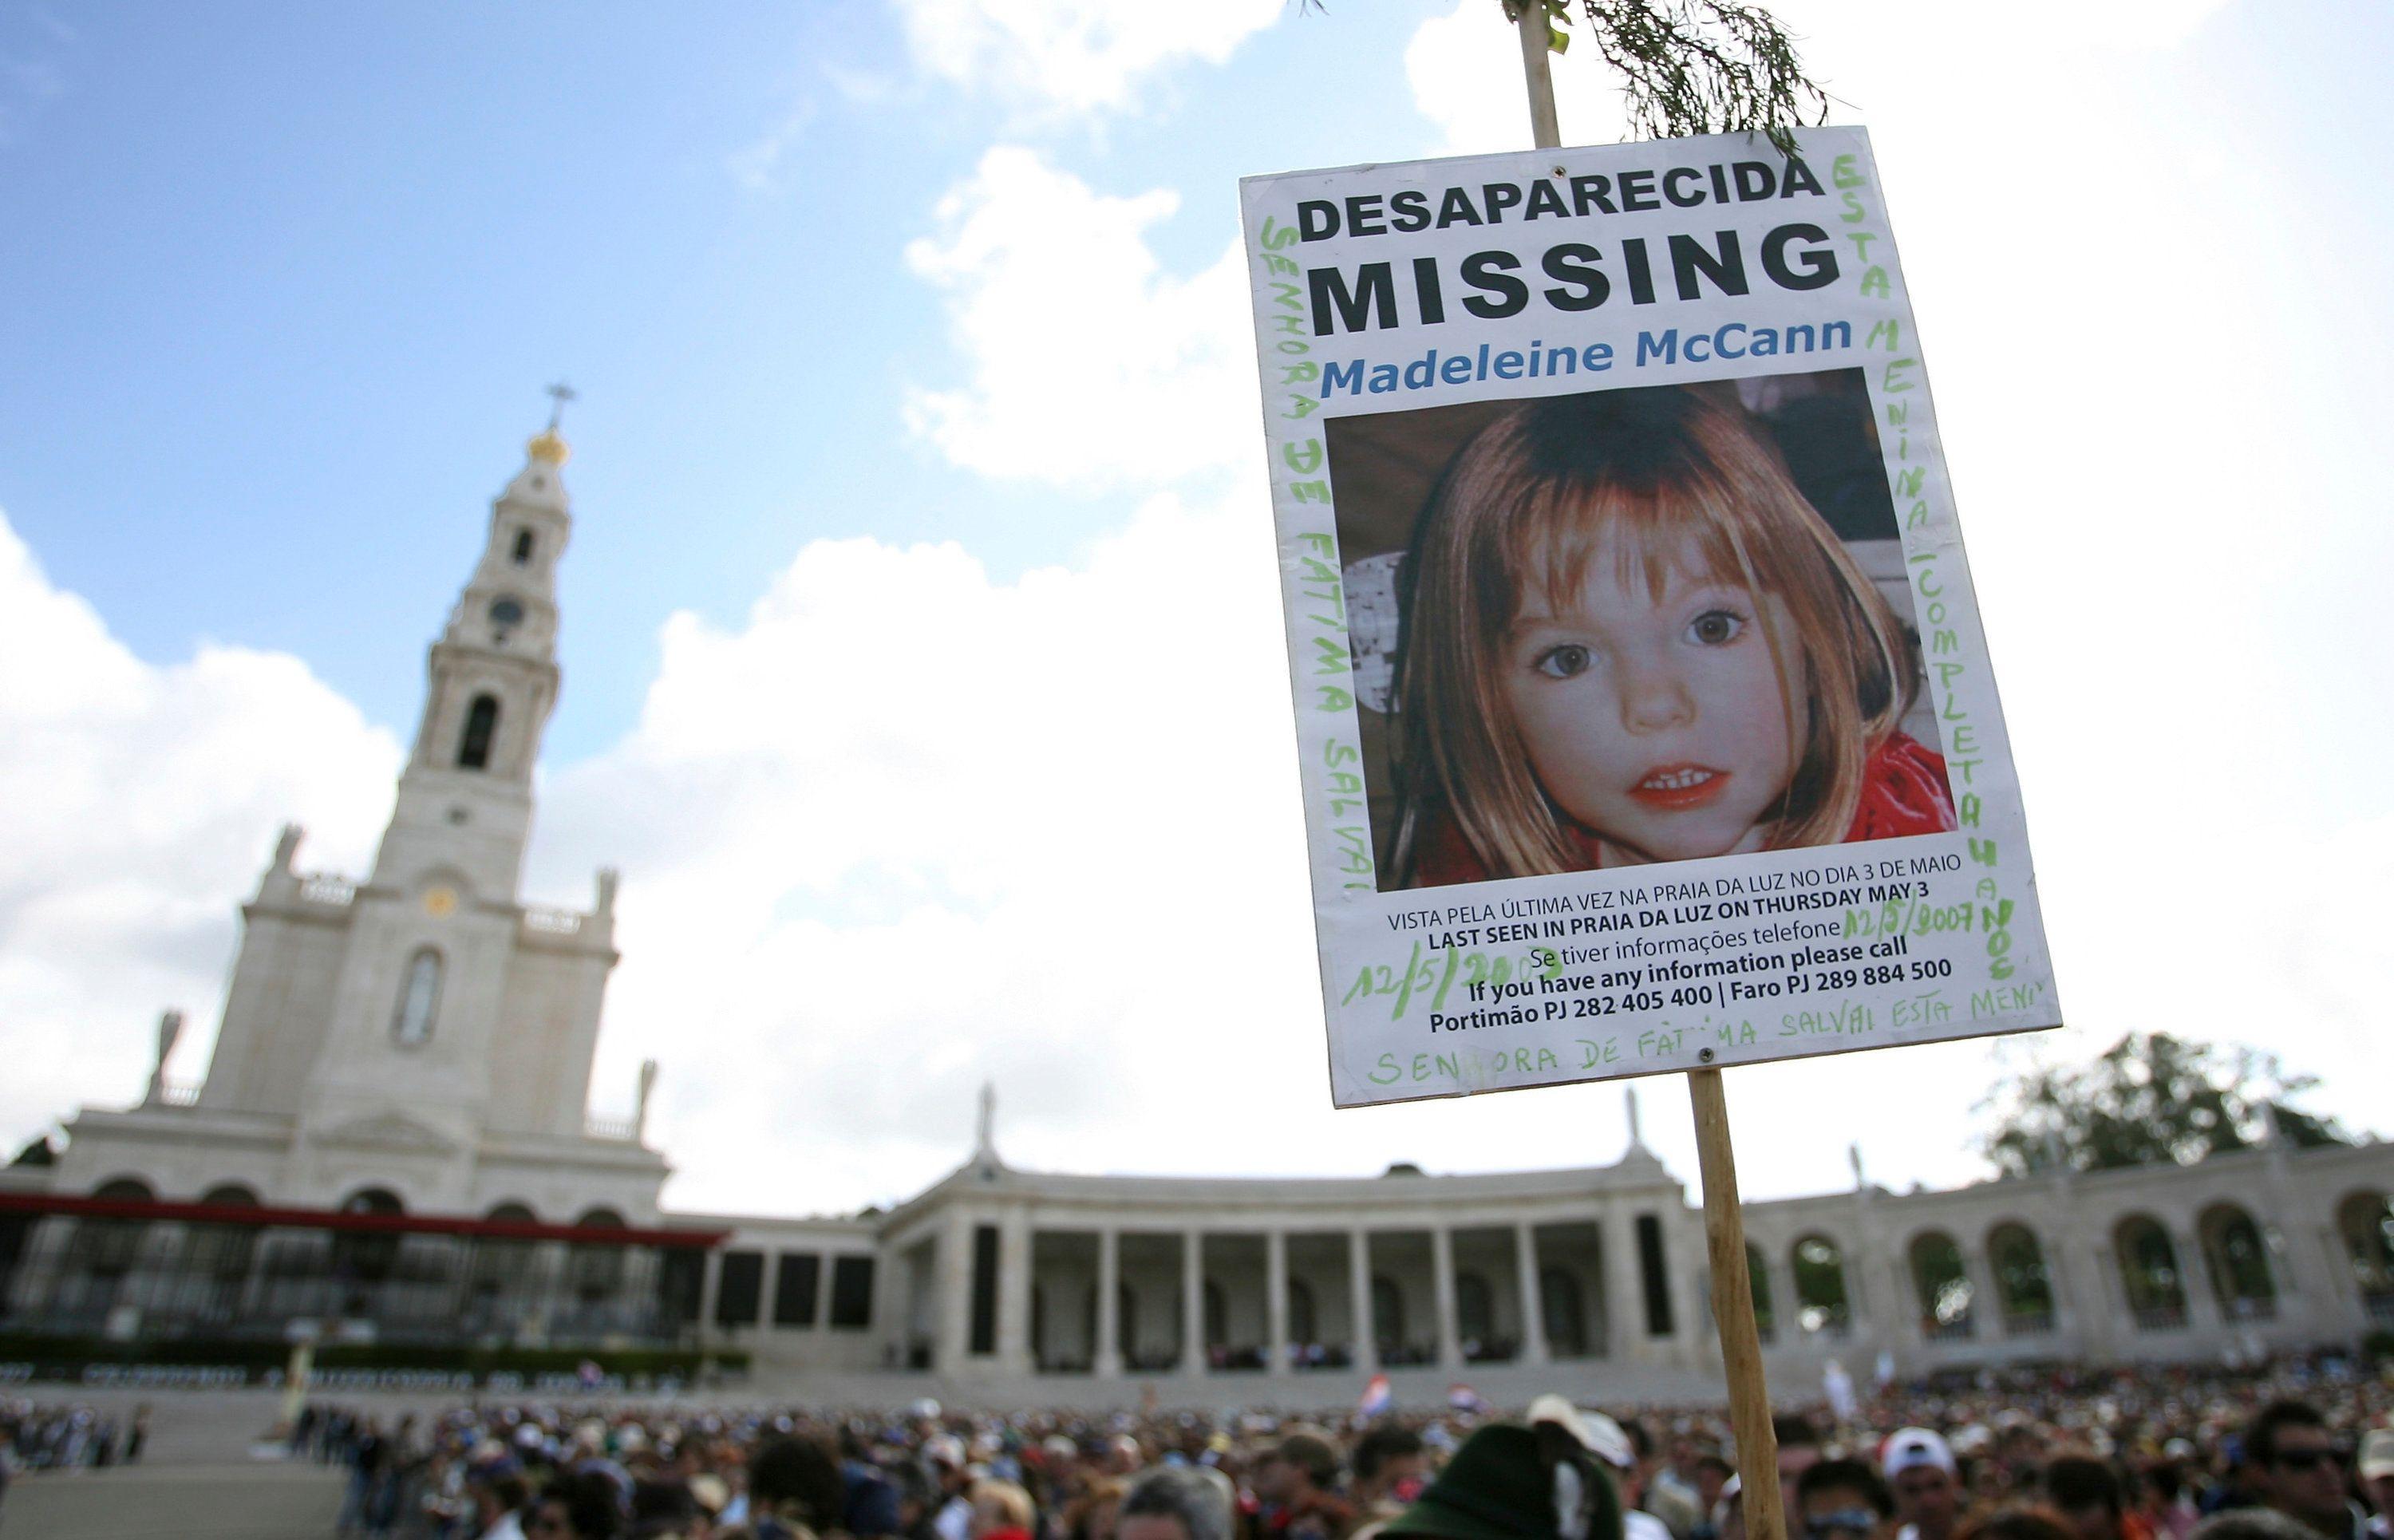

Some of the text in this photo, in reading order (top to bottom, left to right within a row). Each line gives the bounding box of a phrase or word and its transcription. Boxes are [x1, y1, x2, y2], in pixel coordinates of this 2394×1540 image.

[1298, 157, 1825, 243] DESAPARECIDA
[1832, 154, 1891, 299] ESTA
[1307, 223, 1842, 337] MISSING
[1321, 320, 1853, 398] Madeleine McCann
[1282, 438, 1332, 505] DE
[1388, 854, 1961, 930] VISTA PELA ÚLTIMA VEZ NA PRAIA DA LUZ NO DIA 3 DE MAIO
[1429, 881, 1930, 950] LAST SEEN IN PRAIA DA LUZ ON THURSDAY MAY 3
[1469, 935, 1908, 1005] If you have any information please call
[1531, 920, 1840, 969] Se tiver informações telefone
[1430, 1004, 1539, 1033] Portimão
[1544, 1001, 1566, 1021] PJ
[1574, 996, 1616, 1018] 282
[1622, 991, 1665, 1013] 405
[1671, 985, 1713, 1008] 400
[1731, 981, 1781, 1001] Faro
[1787, 974, 1810, 994] PJ
[1817, 969, 1858, 992] 289
[1863, 964, 1906, 985] 884
[1911, 958, 1953, 981] 500
[1367, 1047, 1558, 1085] SENORA
